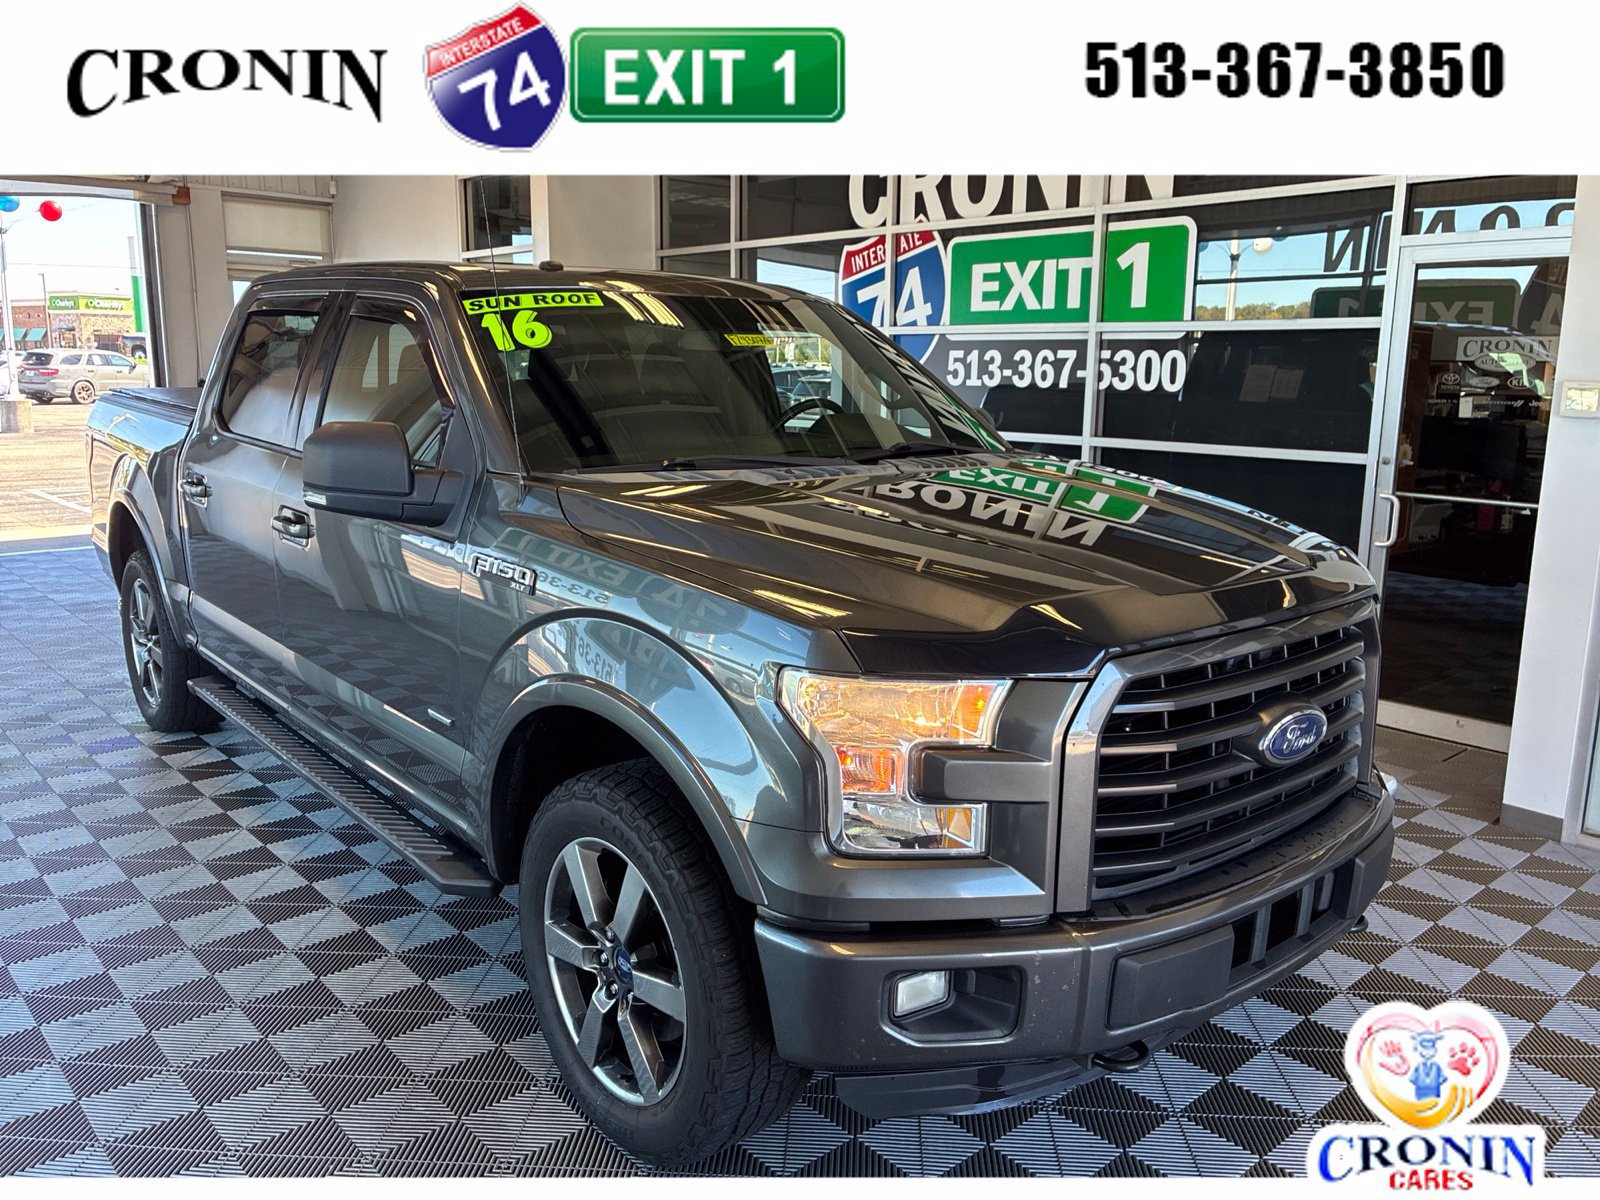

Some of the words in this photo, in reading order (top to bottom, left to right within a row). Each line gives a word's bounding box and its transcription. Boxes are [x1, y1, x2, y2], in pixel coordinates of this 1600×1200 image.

[851, 232, 923, 273] INTERATE
[856, 266, 933, 326] 74
[970, 257, 1093, 312] EXIT
[1116, 242, 1151, 308] 1
[469, 296, 521, 311] SUN
[533, 294, 597, 305] ROOF
[481, 310, 553, 351] 16
[946, 350, 1187, 393] 513-367-5300
[510, 582, 525, 591] XLT
[1283, 721, 1317, 753] Ford
